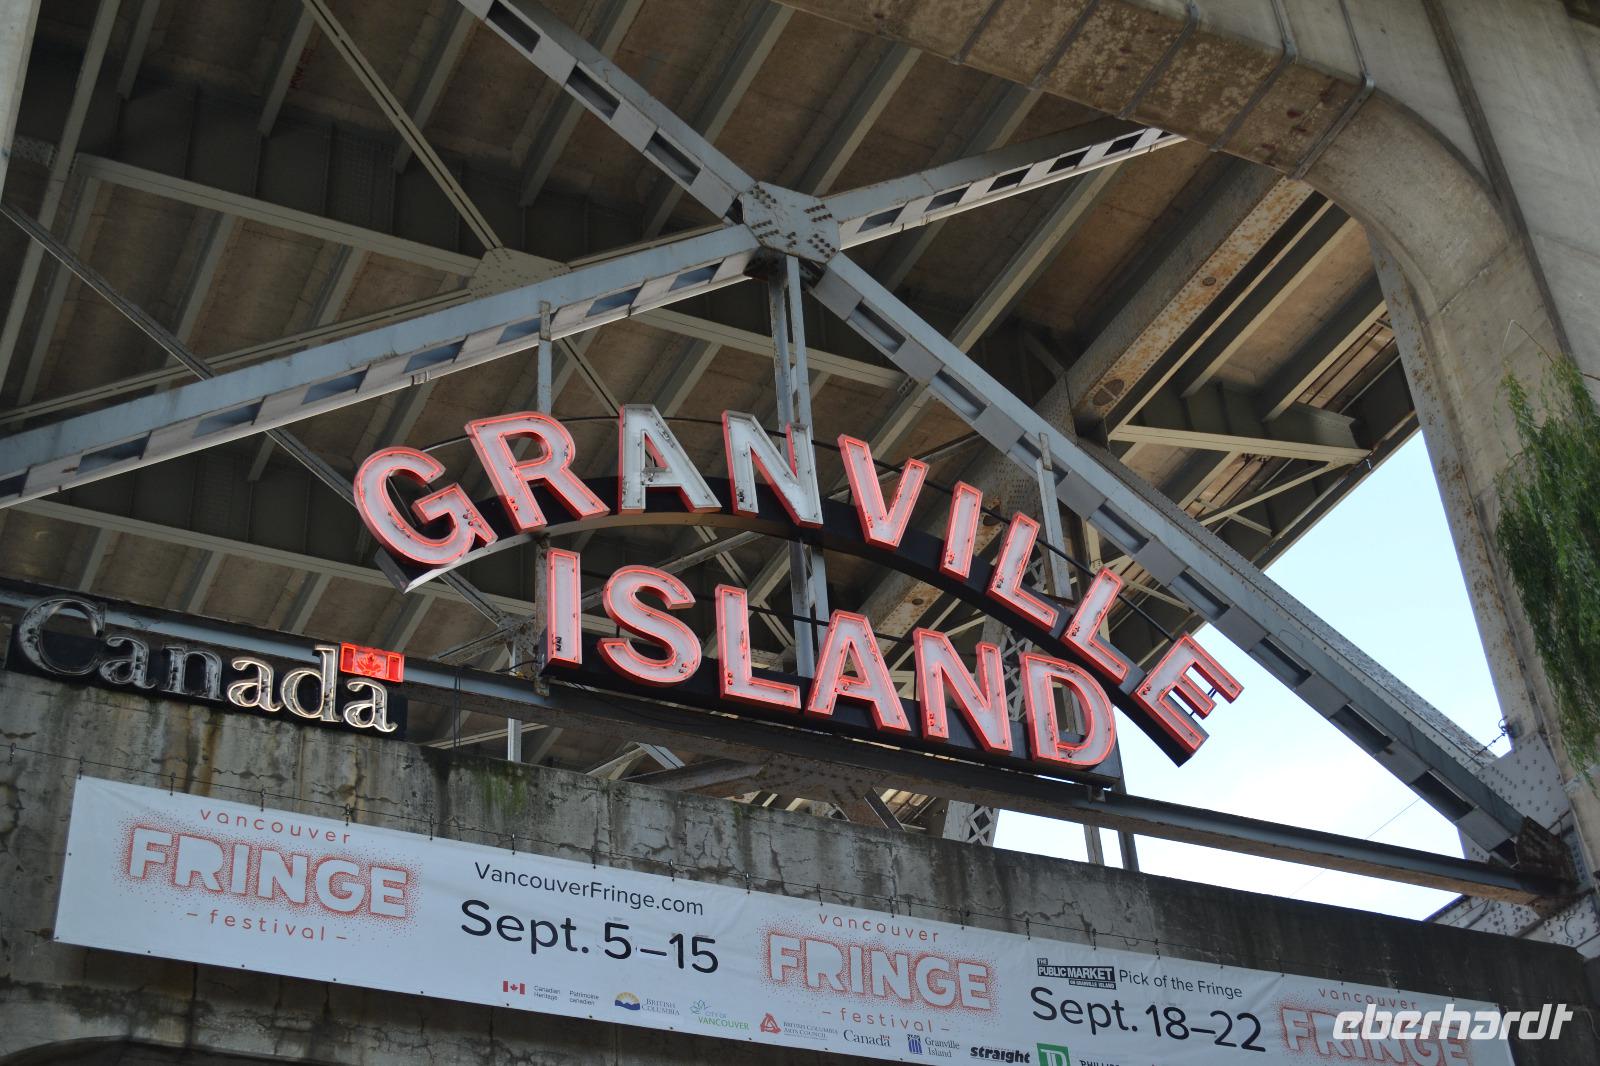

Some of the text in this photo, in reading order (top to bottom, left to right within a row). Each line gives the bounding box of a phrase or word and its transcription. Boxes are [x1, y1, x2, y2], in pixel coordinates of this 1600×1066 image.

[353, 403, 1245, 757] GRANVILLE
[17, 596, 399, 734] Canada
[544, 548, 1116, 769] ISLAND
[200, 808, 351, 845] vancouver
[127, 822, 411, 920] FRINGE
[474, 861, 704, 916] VancouverFringe.com
[209, 908, 326, 942] festival
[461, 899, 590, 955] Sept.
[818, 912, 940, 943] vancouver
[767, 931, 993, 1011] FRINGE
[1038, 966, 1113, 981] PUBLIC MARKET
[1119, 969, 1243, 1000] Pick of the Fringe
[1030, 986, 1139, 1036] Sept.
[1318, 987, 1418, 1010] vancouver
[697, 1016, 750, 1031] VANCOUVER
[839, 1006, 933, 1034] festival
[843, 1028, 892, 1048] Canada
[924, 1036, 961, 1051] Granville
[927, 1046, 953, 1058] Island
[969, 1046, 1031, 1064] straight
